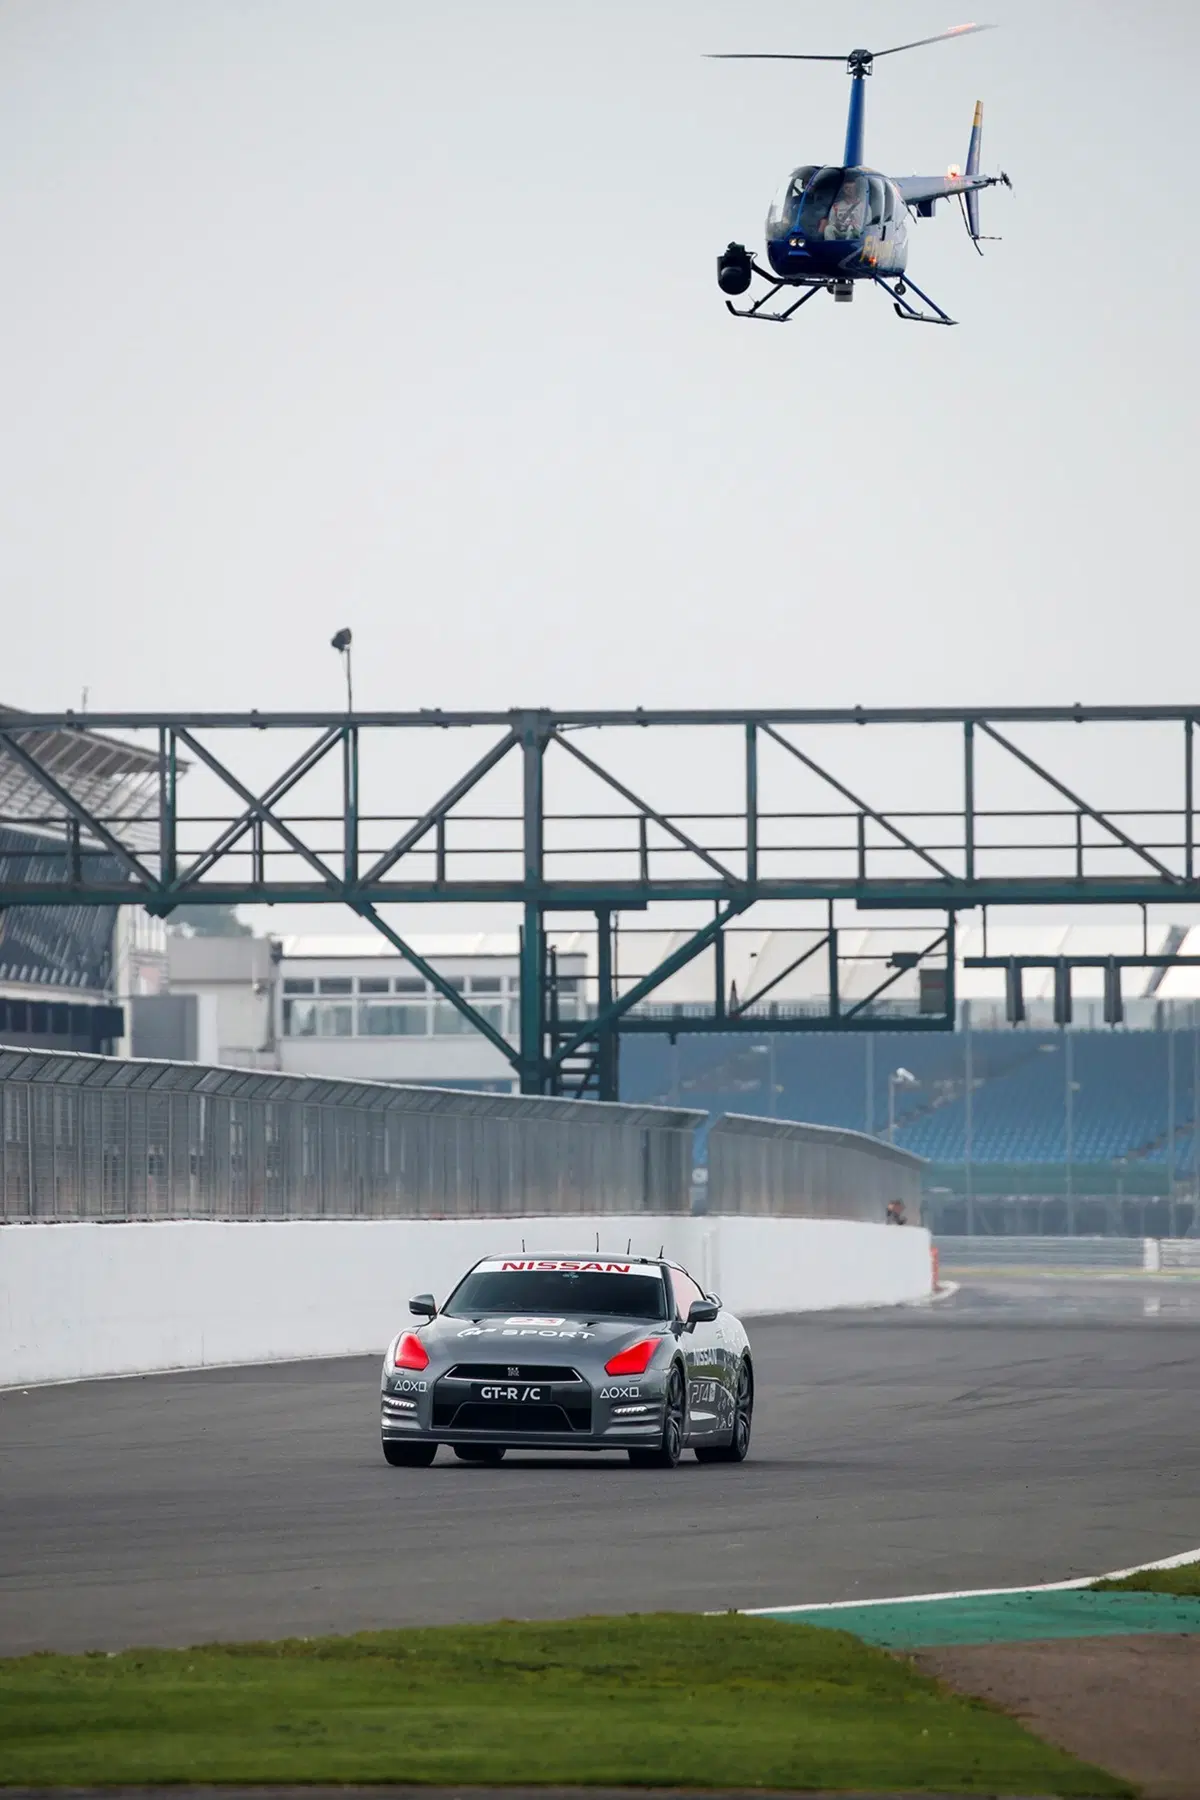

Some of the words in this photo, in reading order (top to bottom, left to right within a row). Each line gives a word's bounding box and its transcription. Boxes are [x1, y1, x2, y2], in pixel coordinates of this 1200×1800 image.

[501, 1261, 631, 1273] NISSAN
[501, 1329, 596, 1340] SPORT
[693, 1348, 717, 1366] NISSAN
[481, 1386, 517, 1400] GT-R
